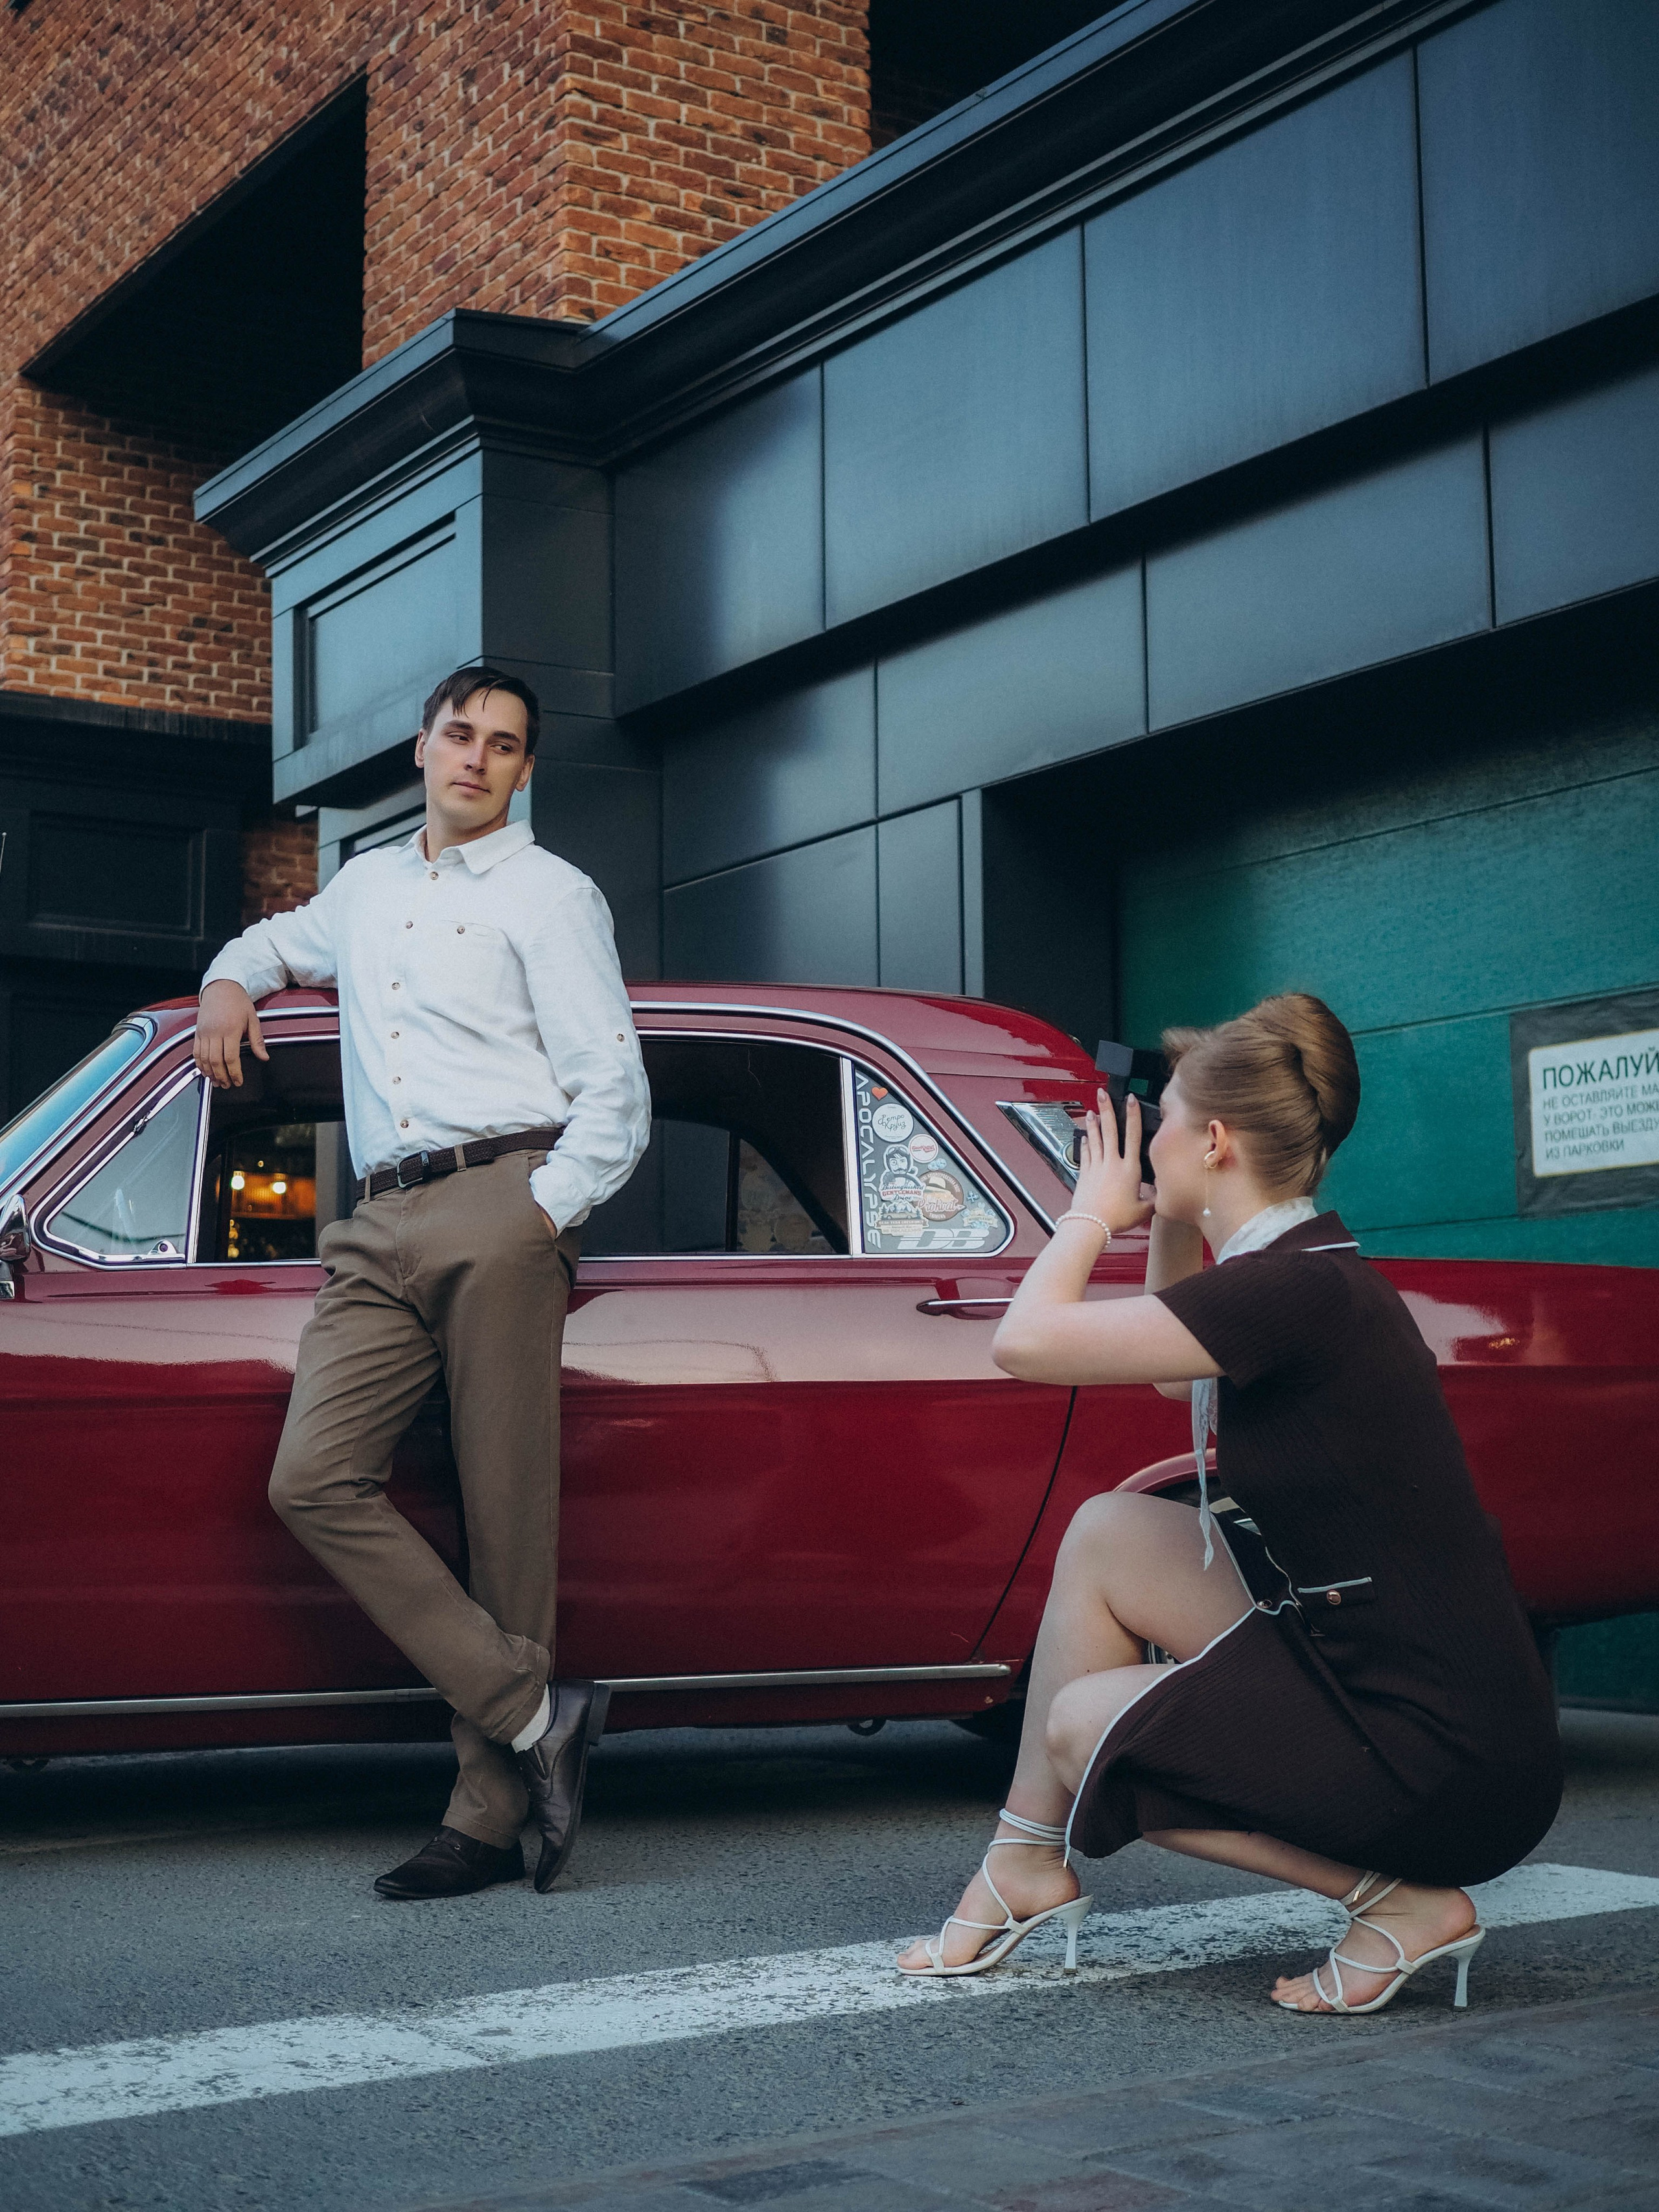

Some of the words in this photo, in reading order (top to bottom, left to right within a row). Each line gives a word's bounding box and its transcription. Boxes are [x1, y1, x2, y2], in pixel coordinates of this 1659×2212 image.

[1543, 1098, 1557, 1110] НЕ
[878, 1114, 905, 1124] Ретро
[1544, 1114, 1551, 1126] У
[1600, 1105, 1623, 1119] ЭТО
[882, 1121, 906, 1132] Круиз
[1545, 1124, 1609, 1142] ПОМЕШАТЬ
[1546, 1147, 1560, 1159] ИЗ
[1563, 1139, 1625, 1156] ПАРКОВКИ
[855, 1072, 882, 1249] APOCALYPSE
[918, 1198, 959, 1212] Prohvat
